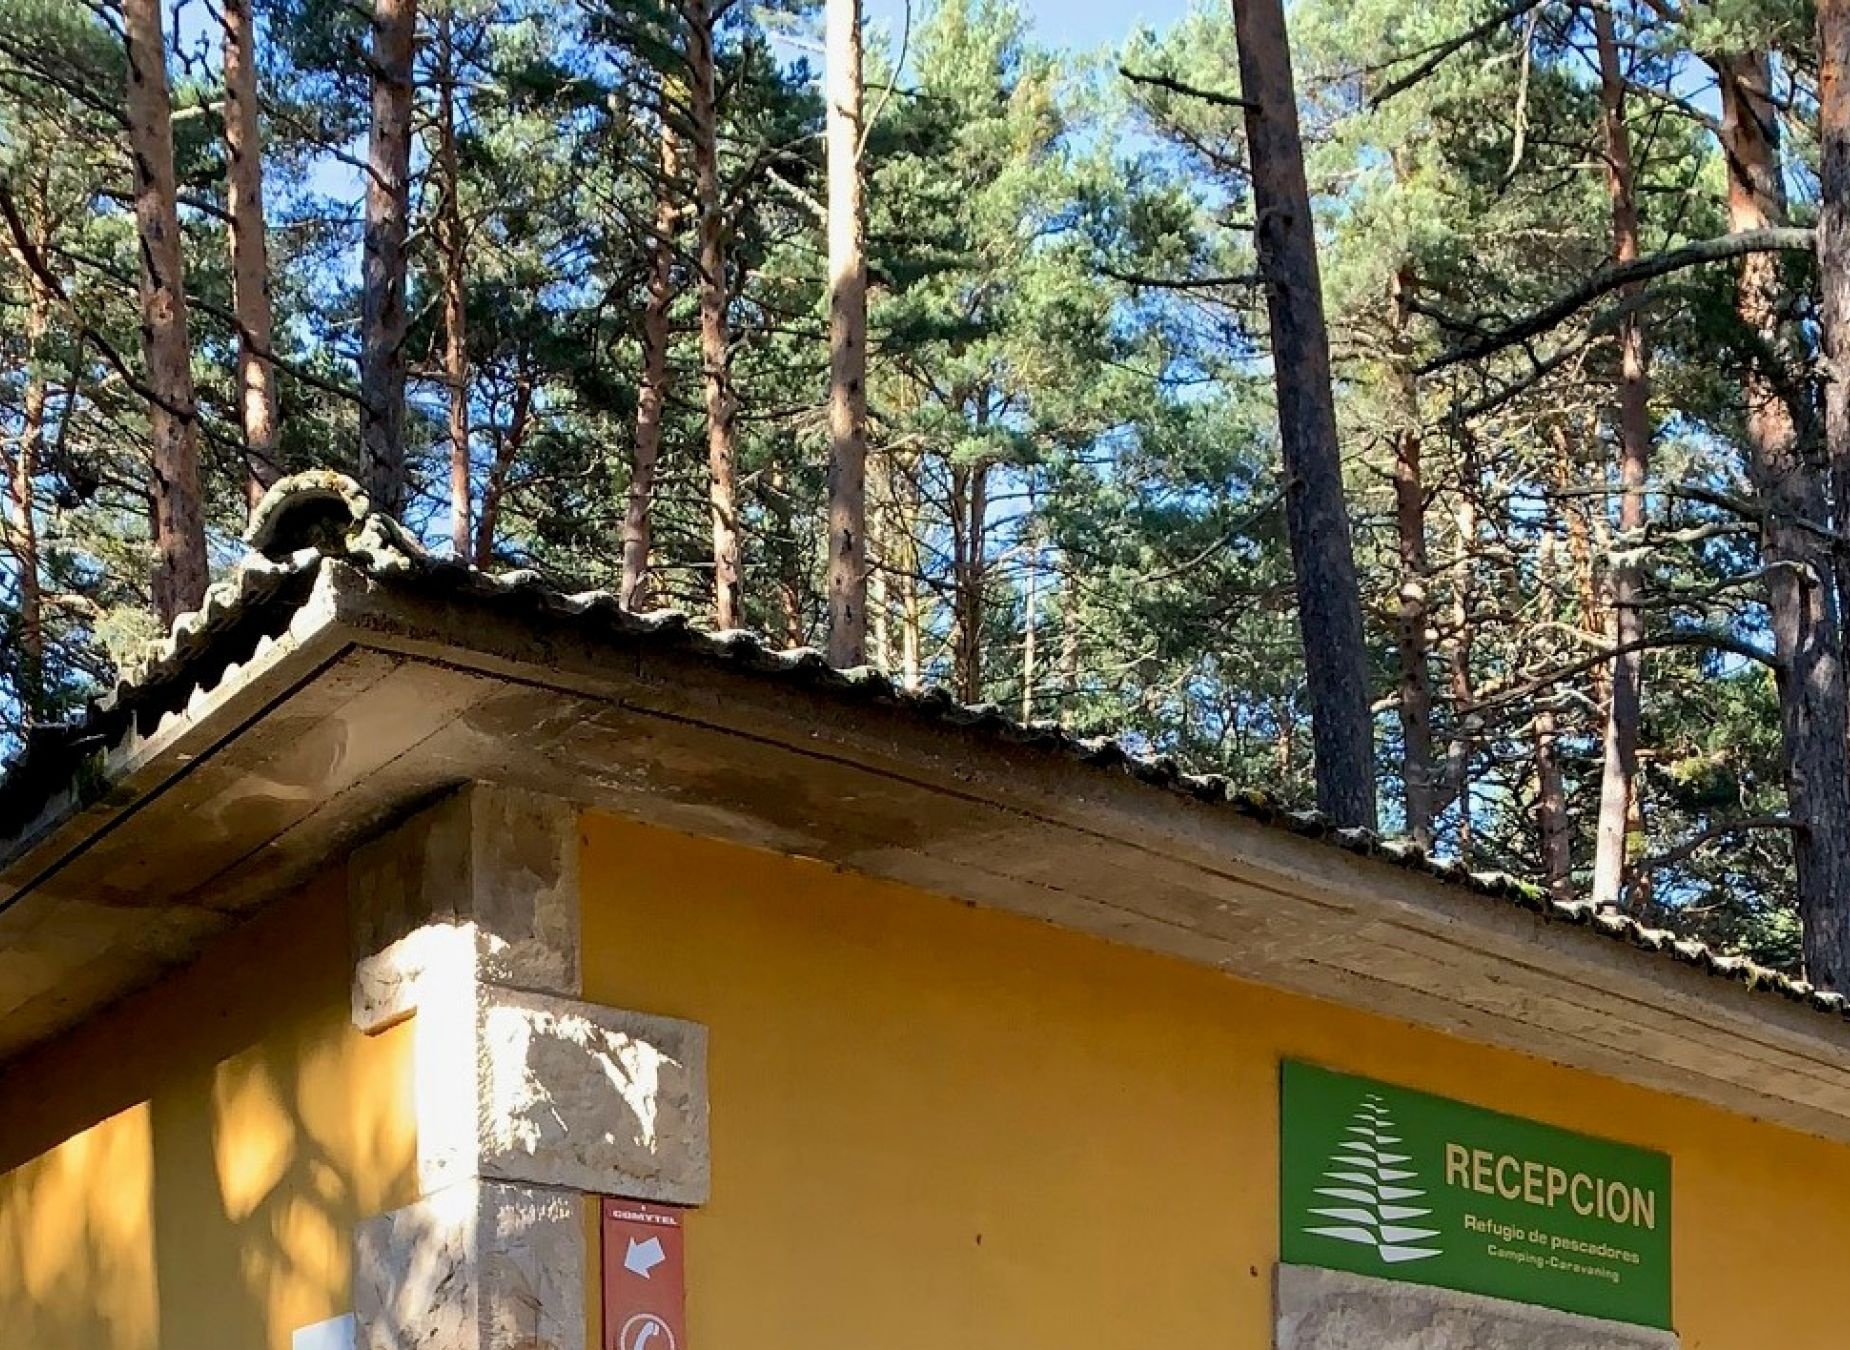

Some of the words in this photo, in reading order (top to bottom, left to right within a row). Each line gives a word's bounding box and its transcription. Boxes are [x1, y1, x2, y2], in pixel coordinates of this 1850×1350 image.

[1445, 1142, 1655, 1229] RECEPCION
[1464, 1213, 1525, 1242] Refugio
[1528, 1228, 1548, 1245] de
[1551, 1235, 1640, 1265] pescadores
